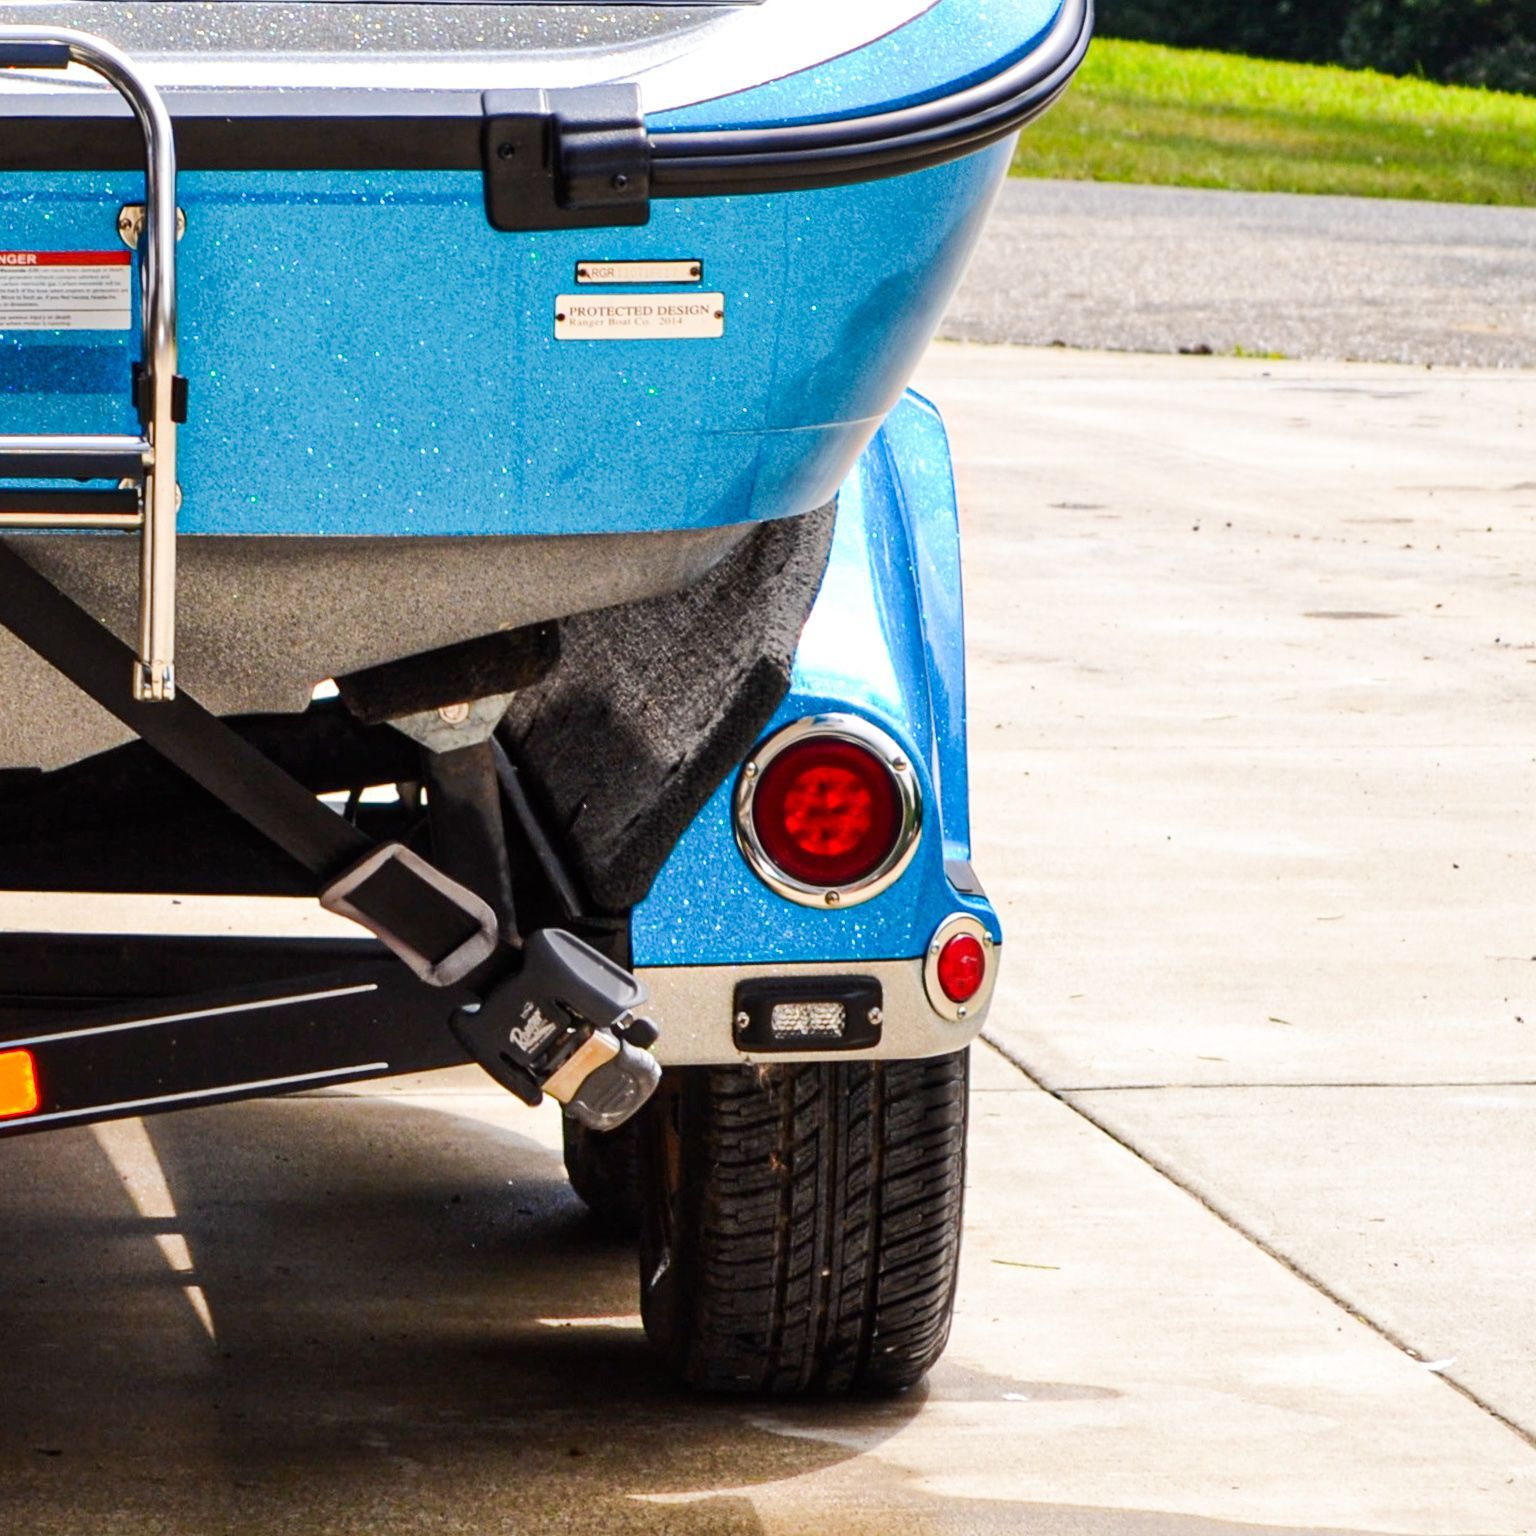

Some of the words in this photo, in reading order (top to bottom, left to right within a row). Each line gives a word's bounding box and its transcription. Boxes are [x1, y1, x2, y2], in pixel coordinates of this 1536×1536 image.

[591, 267, 615, 278] RGR
[569, 305, 653, 317] PROTECTED
[657, 303, 710, 316] DESIGN
[659, 316, 683, 327] 2014
